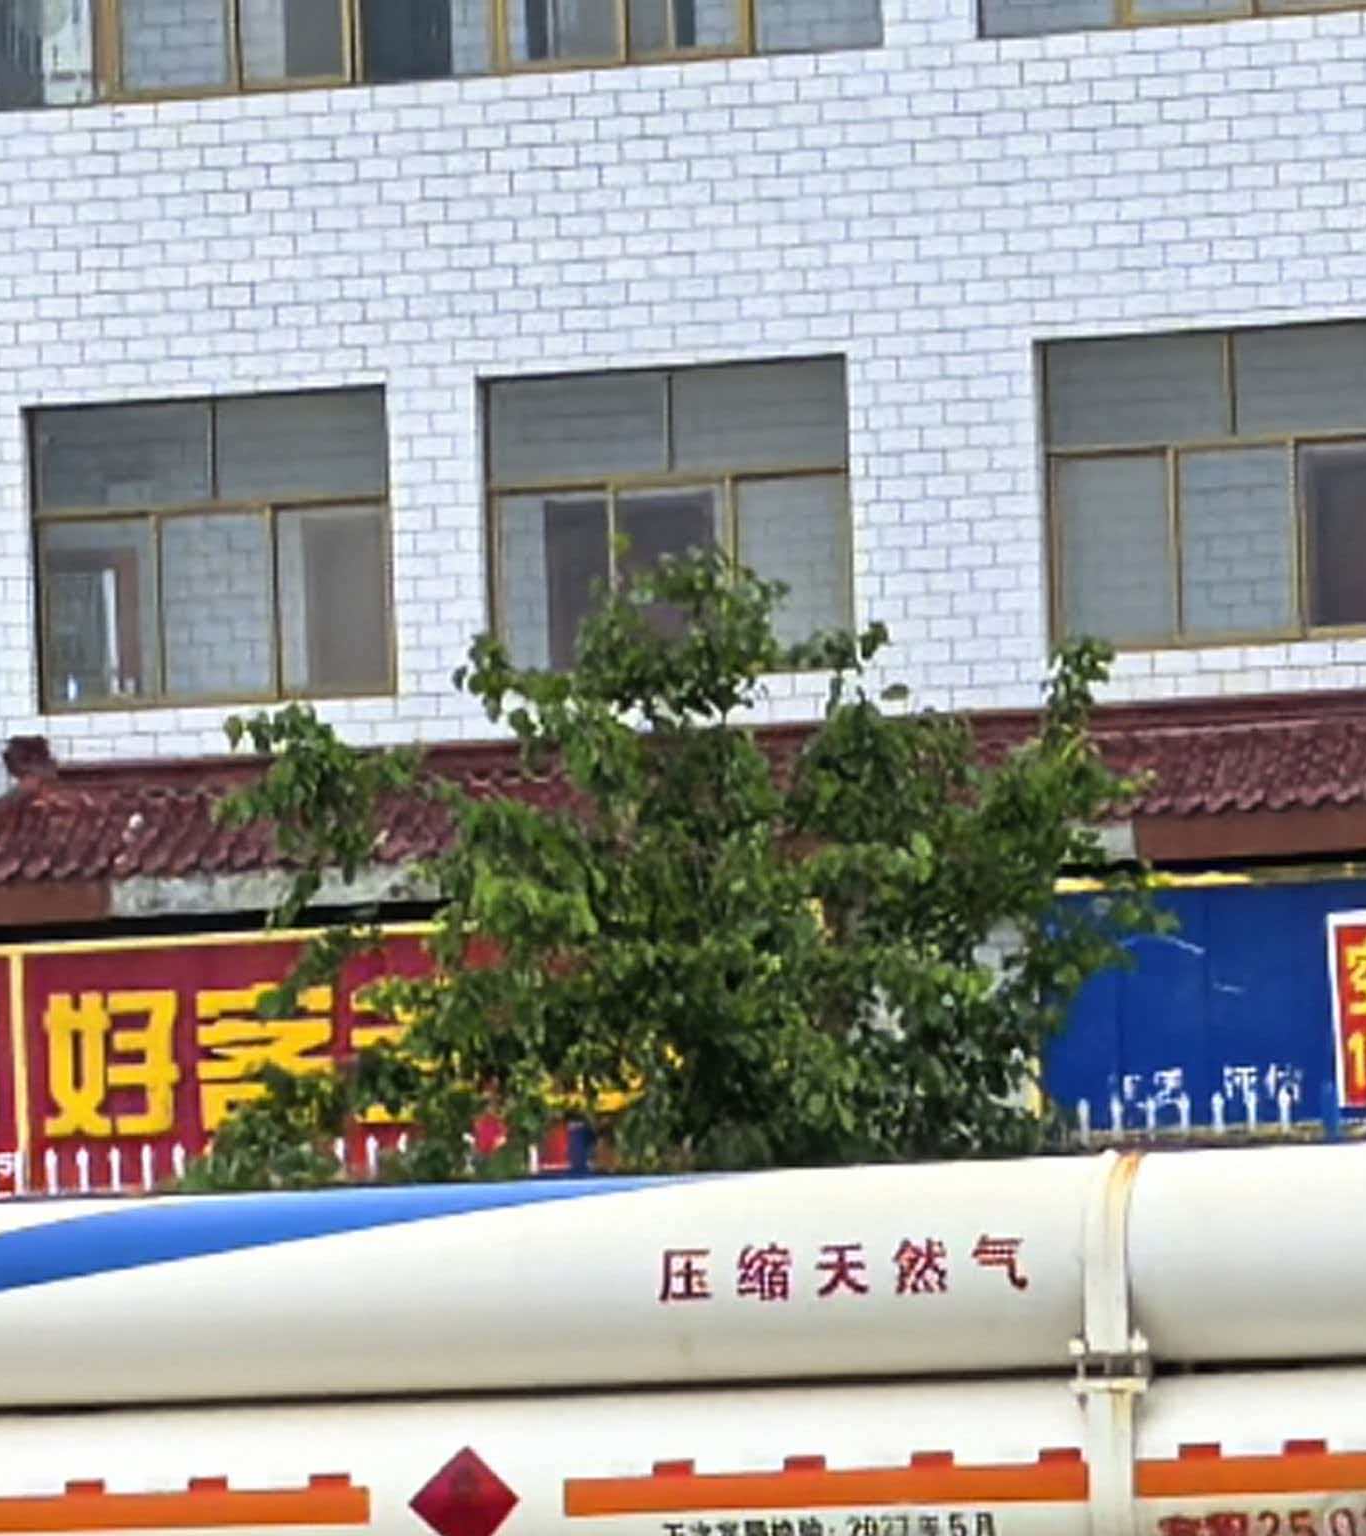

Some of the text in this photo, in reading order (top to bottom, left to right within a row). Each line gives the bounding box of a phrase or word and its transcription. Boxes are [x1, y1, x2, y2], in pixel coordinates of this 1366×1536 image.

[658, 1233, 1030, 1303] 压缩天然气
